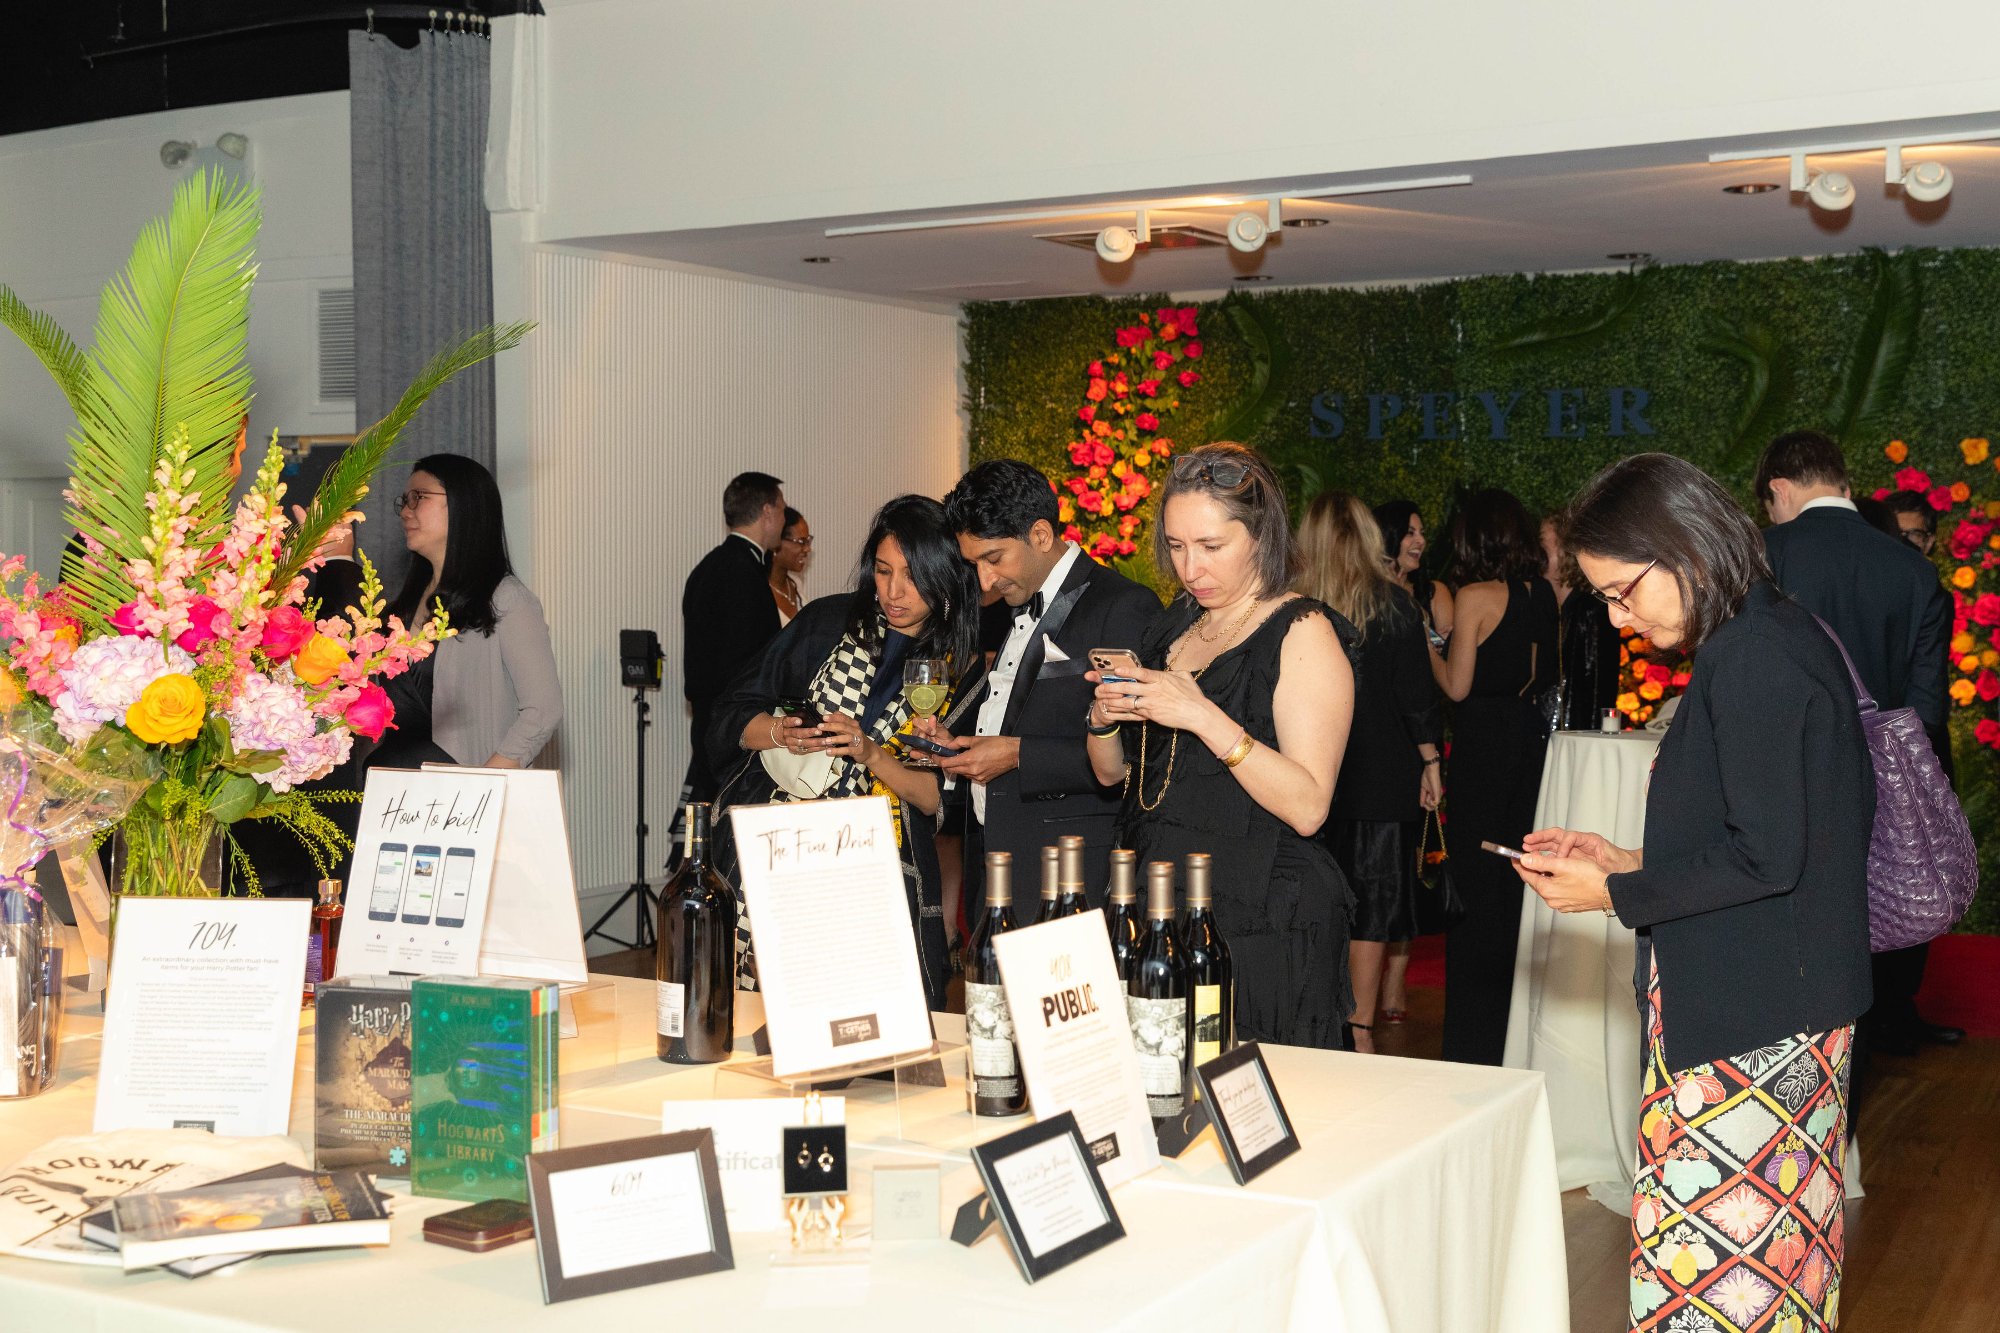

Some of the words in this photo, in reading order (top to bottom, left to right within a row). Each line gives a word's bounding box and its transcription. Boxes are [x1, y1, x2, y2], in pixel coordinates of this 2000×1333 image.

[1309, 386, 1655, 440] SPEYER
[381, 789, 420, 833] How
[423, 799, 444, 833] to
[757, 829, 790, 871] The
[795, 828, 829, 864] Fine
[836, 823, 880, 857] Print
[189, 921, 238, 950] 104.
[347, 1003, 398, 1038] Harry
[344, 1109, 364, 1120] THE
[437, 1118, 505, 1144] HOGWARTS
[446, 1143, 495, 1163] LIBRARY
